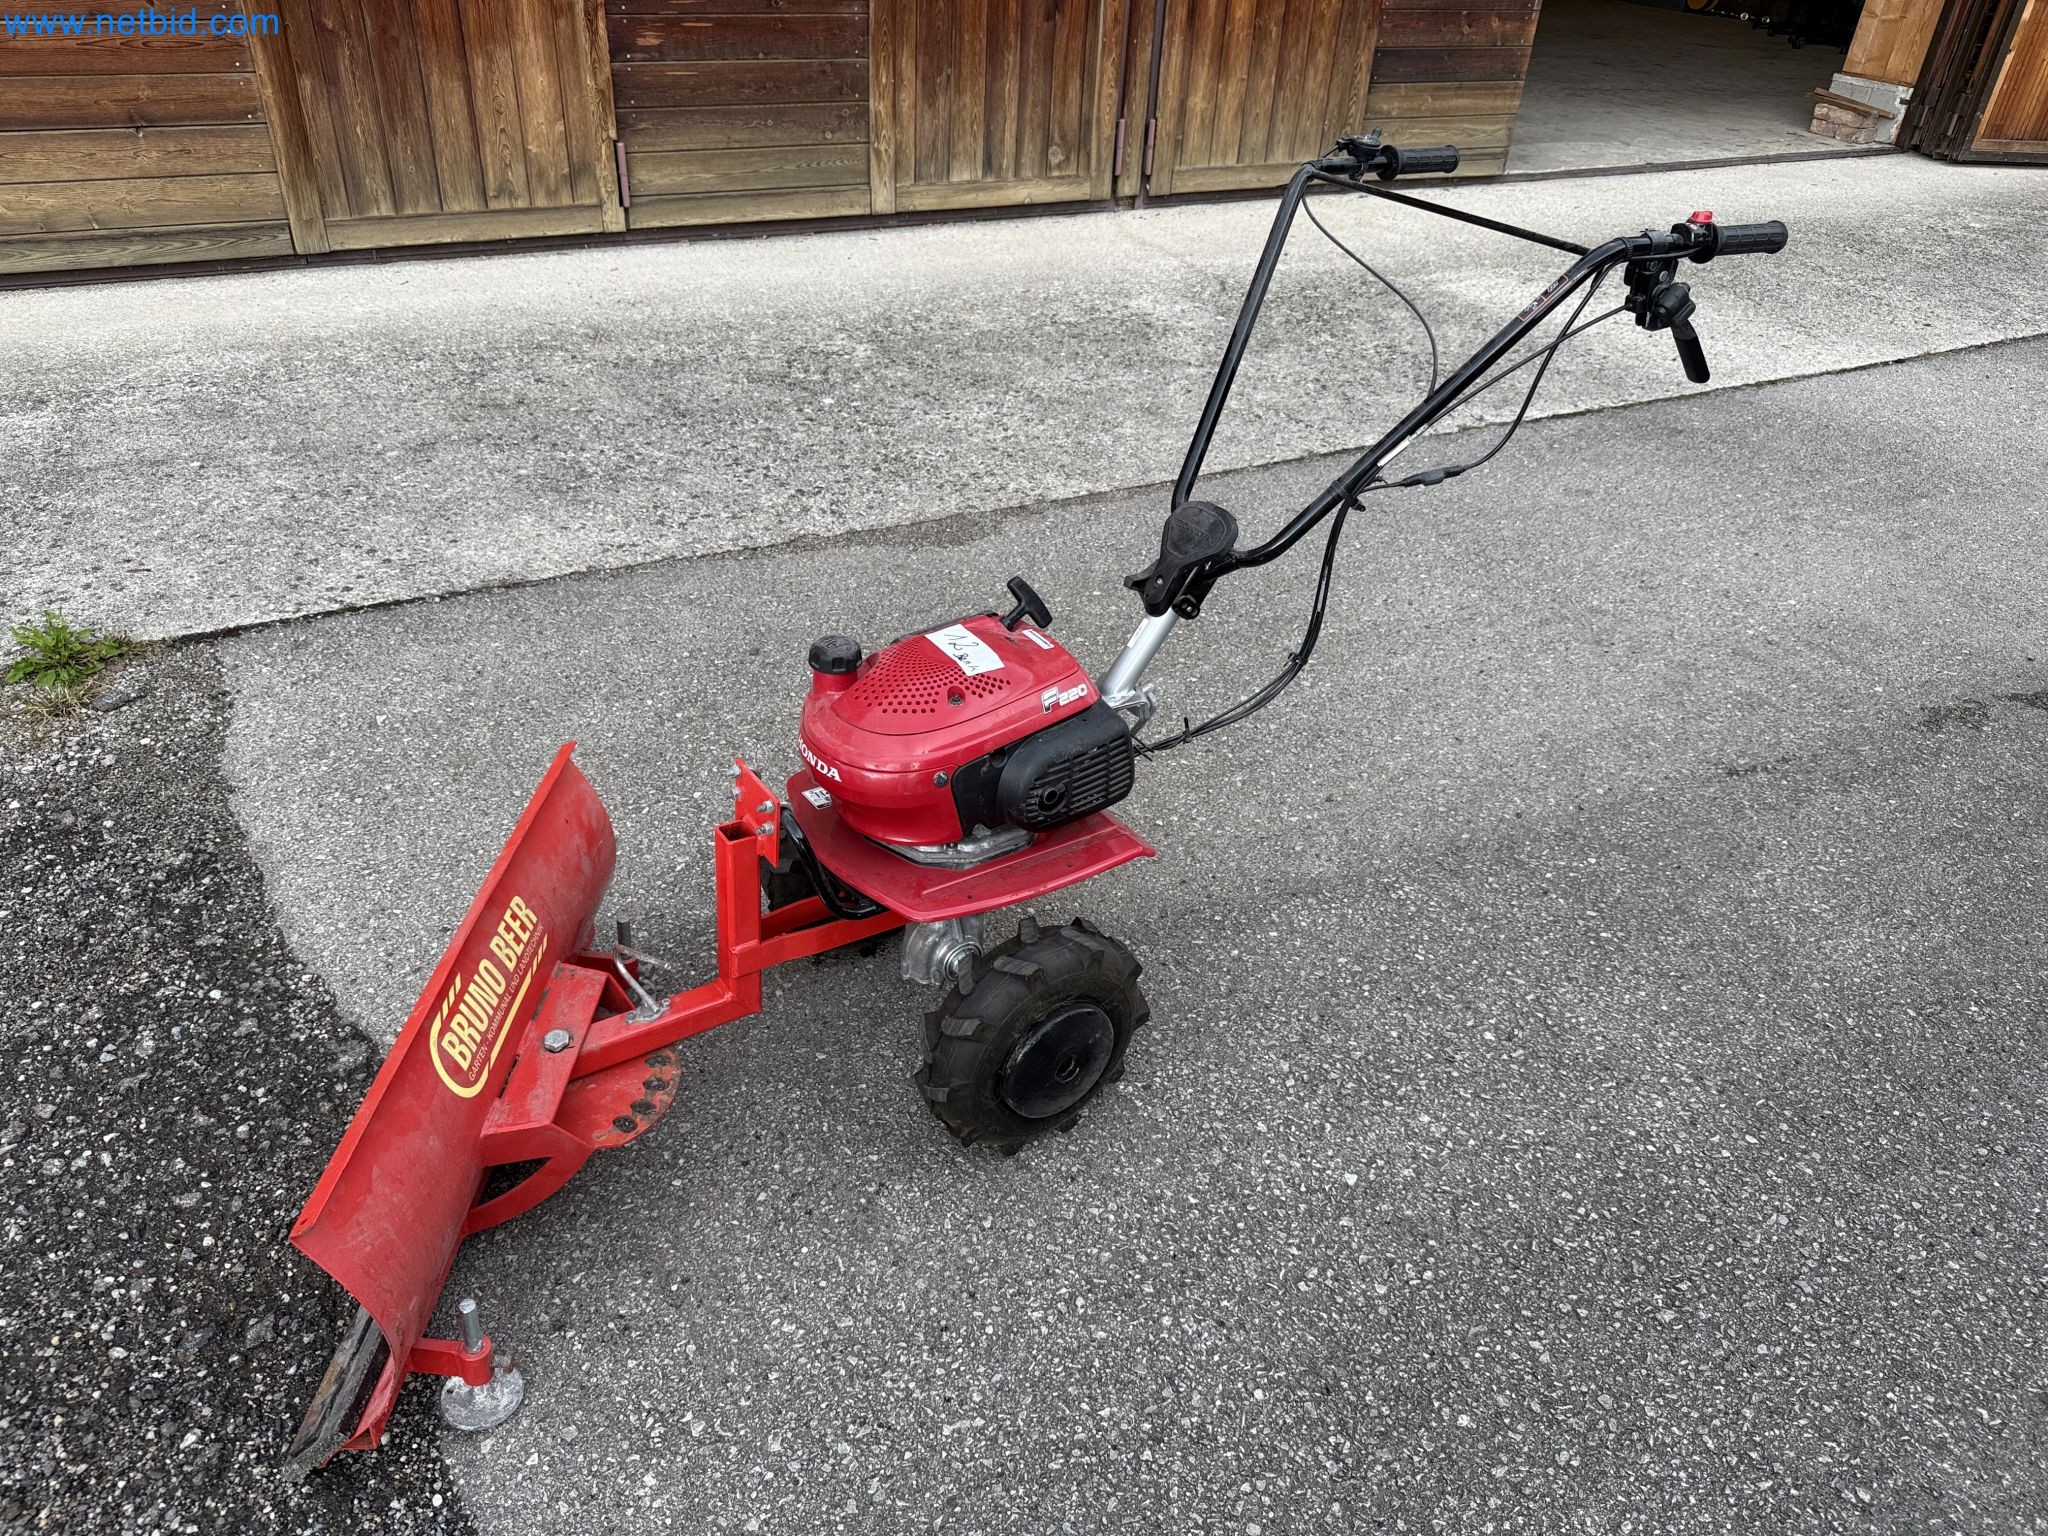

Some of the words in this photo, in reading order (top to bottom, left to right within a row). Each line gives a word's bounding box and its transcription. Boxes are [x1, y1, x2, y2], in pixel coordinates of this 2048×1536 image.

[440, 958, 507, 1072] BRUNO
[489, 895, 538, 972] BEER
[468, 1043, 489, 1081] GARTEN
[486, 992, 513, 1041] KOMMUNAL
[508, 973, 520, 993] UND
[517, 923, 544, 976] LANDTECHNIK
